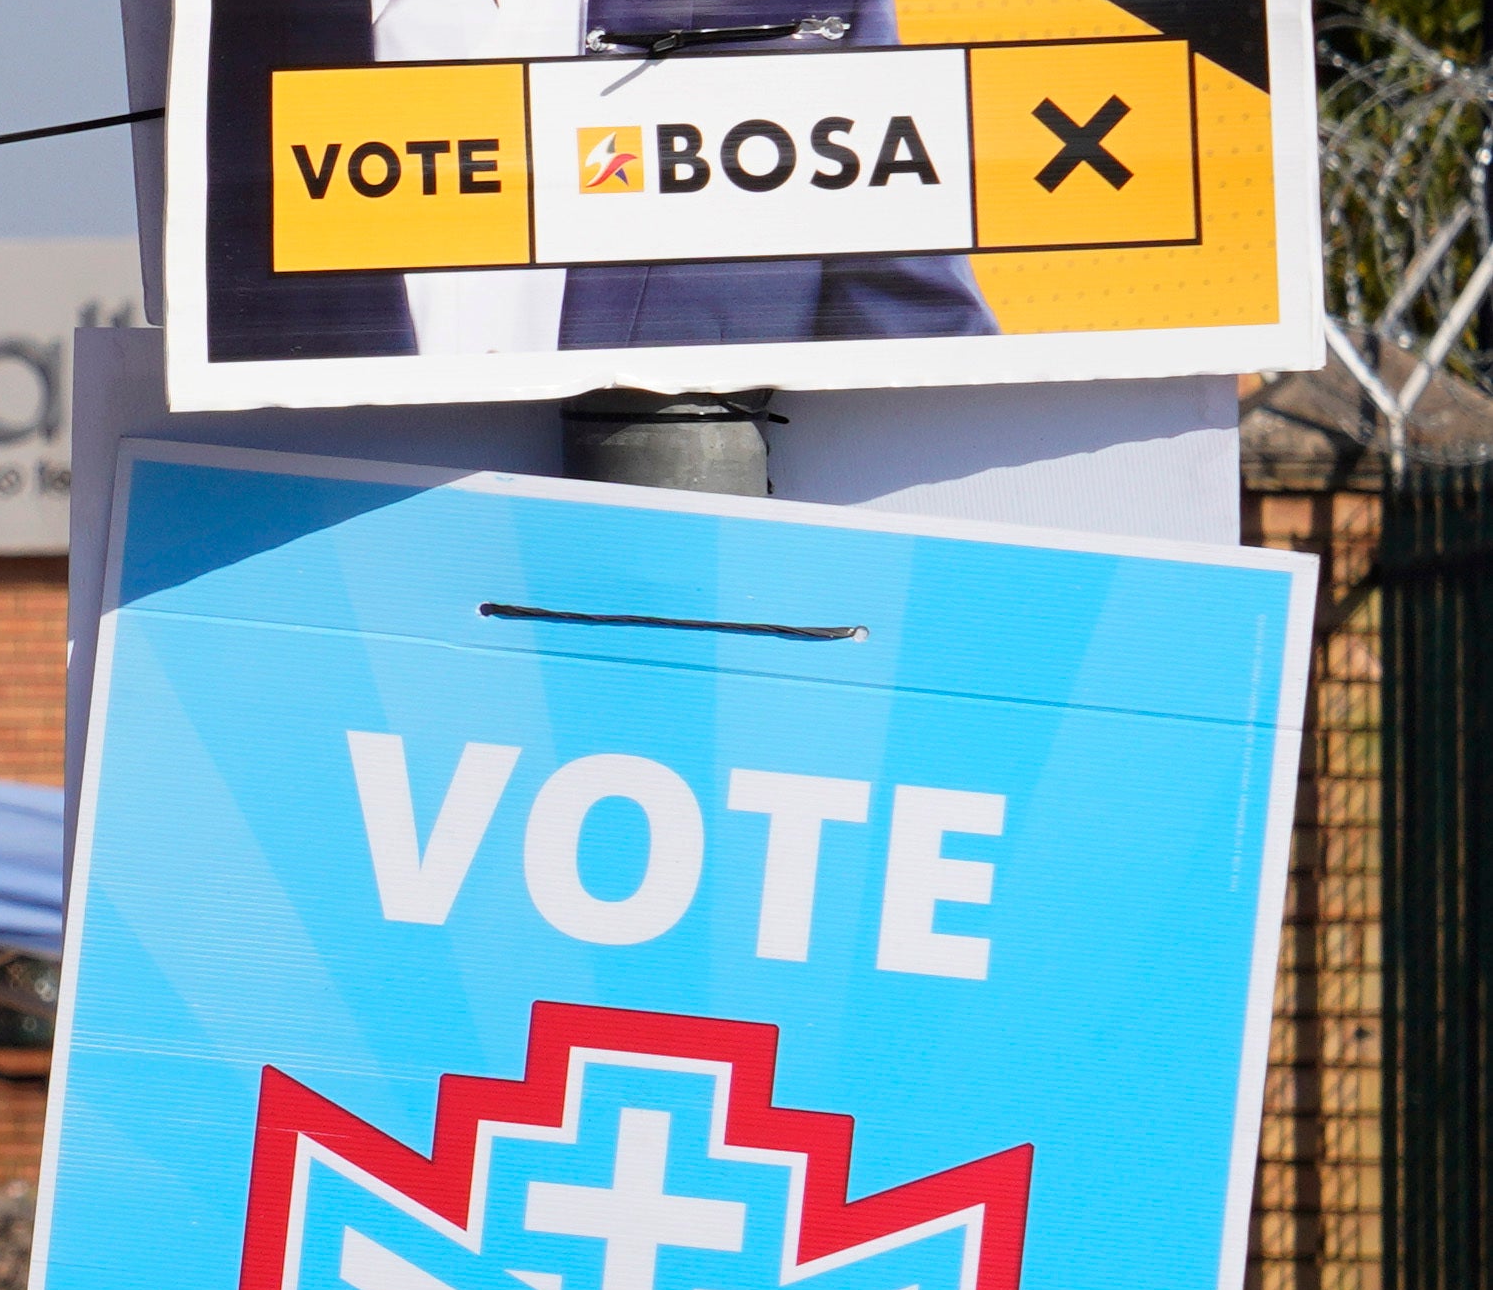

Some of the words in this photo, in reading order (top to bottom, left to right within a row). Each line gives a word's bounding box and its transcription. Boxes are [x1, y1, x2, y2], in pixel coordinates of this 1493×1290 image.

[291, 138, 503, 203] VOTE
[656, 115, 942, 196] BOSA
[345, 731, 1007, 983] VOTE
